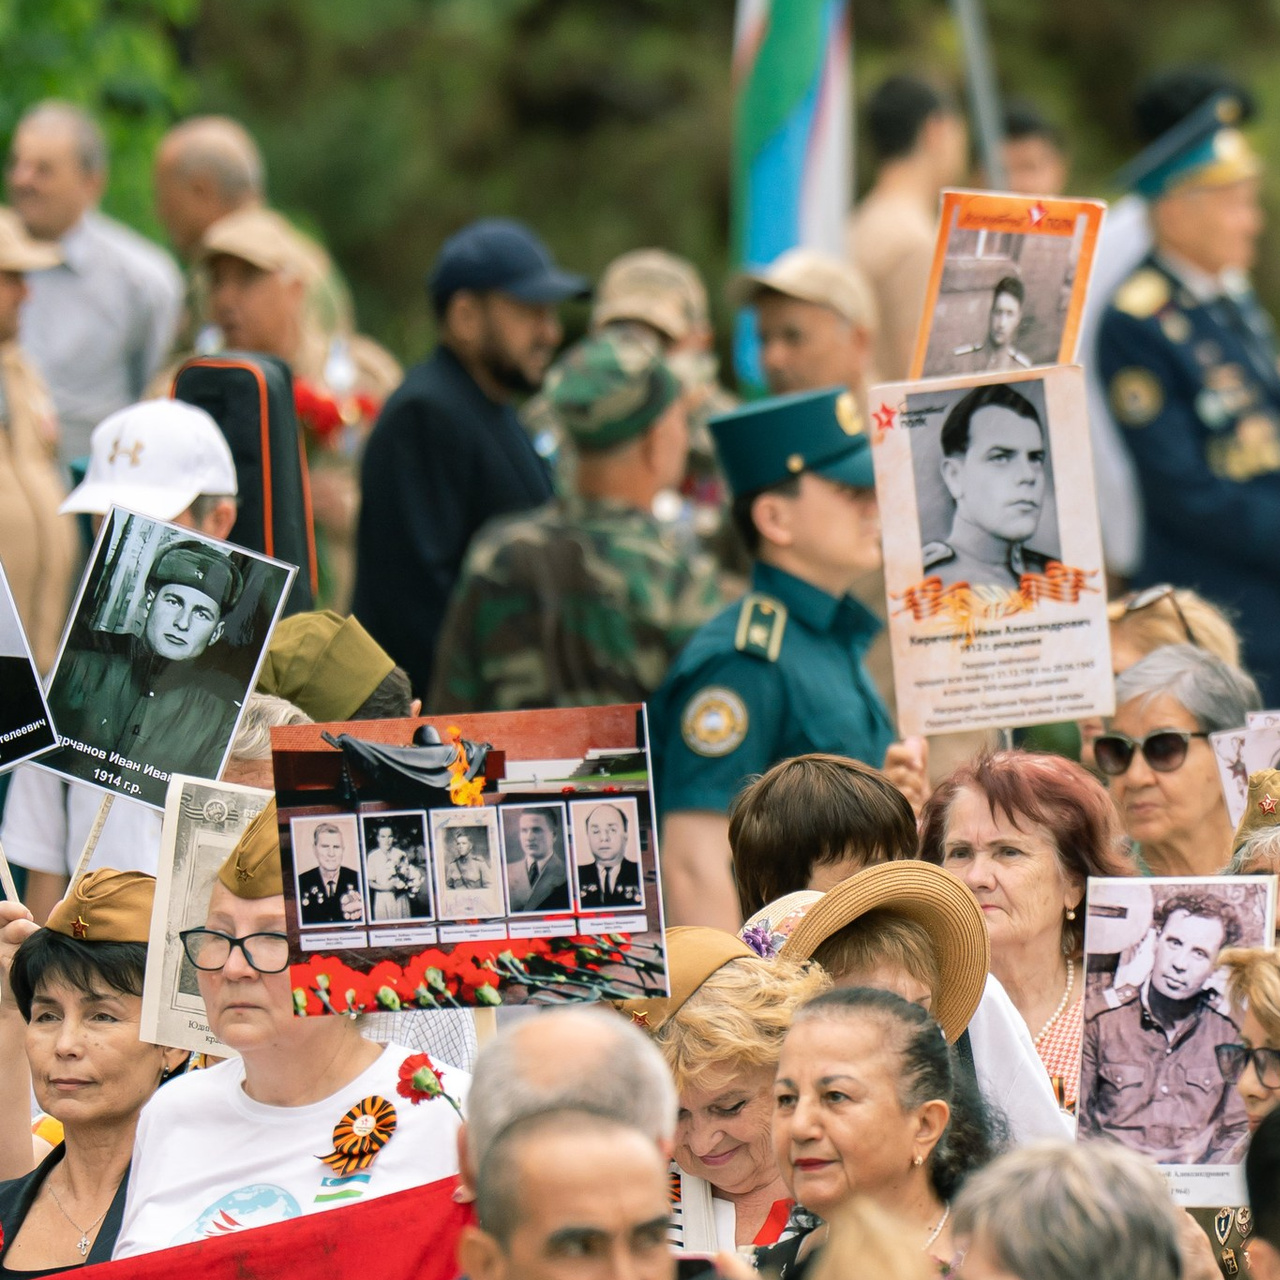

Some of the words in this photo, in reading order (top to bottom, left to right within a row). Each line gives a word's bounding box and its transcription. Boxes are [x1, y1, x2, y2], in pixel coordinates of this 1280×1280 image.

[109, 751, 141, 772] Иван
[94, 768, 121, 787] 1914
[123, 781, 142, 795] г.р.
